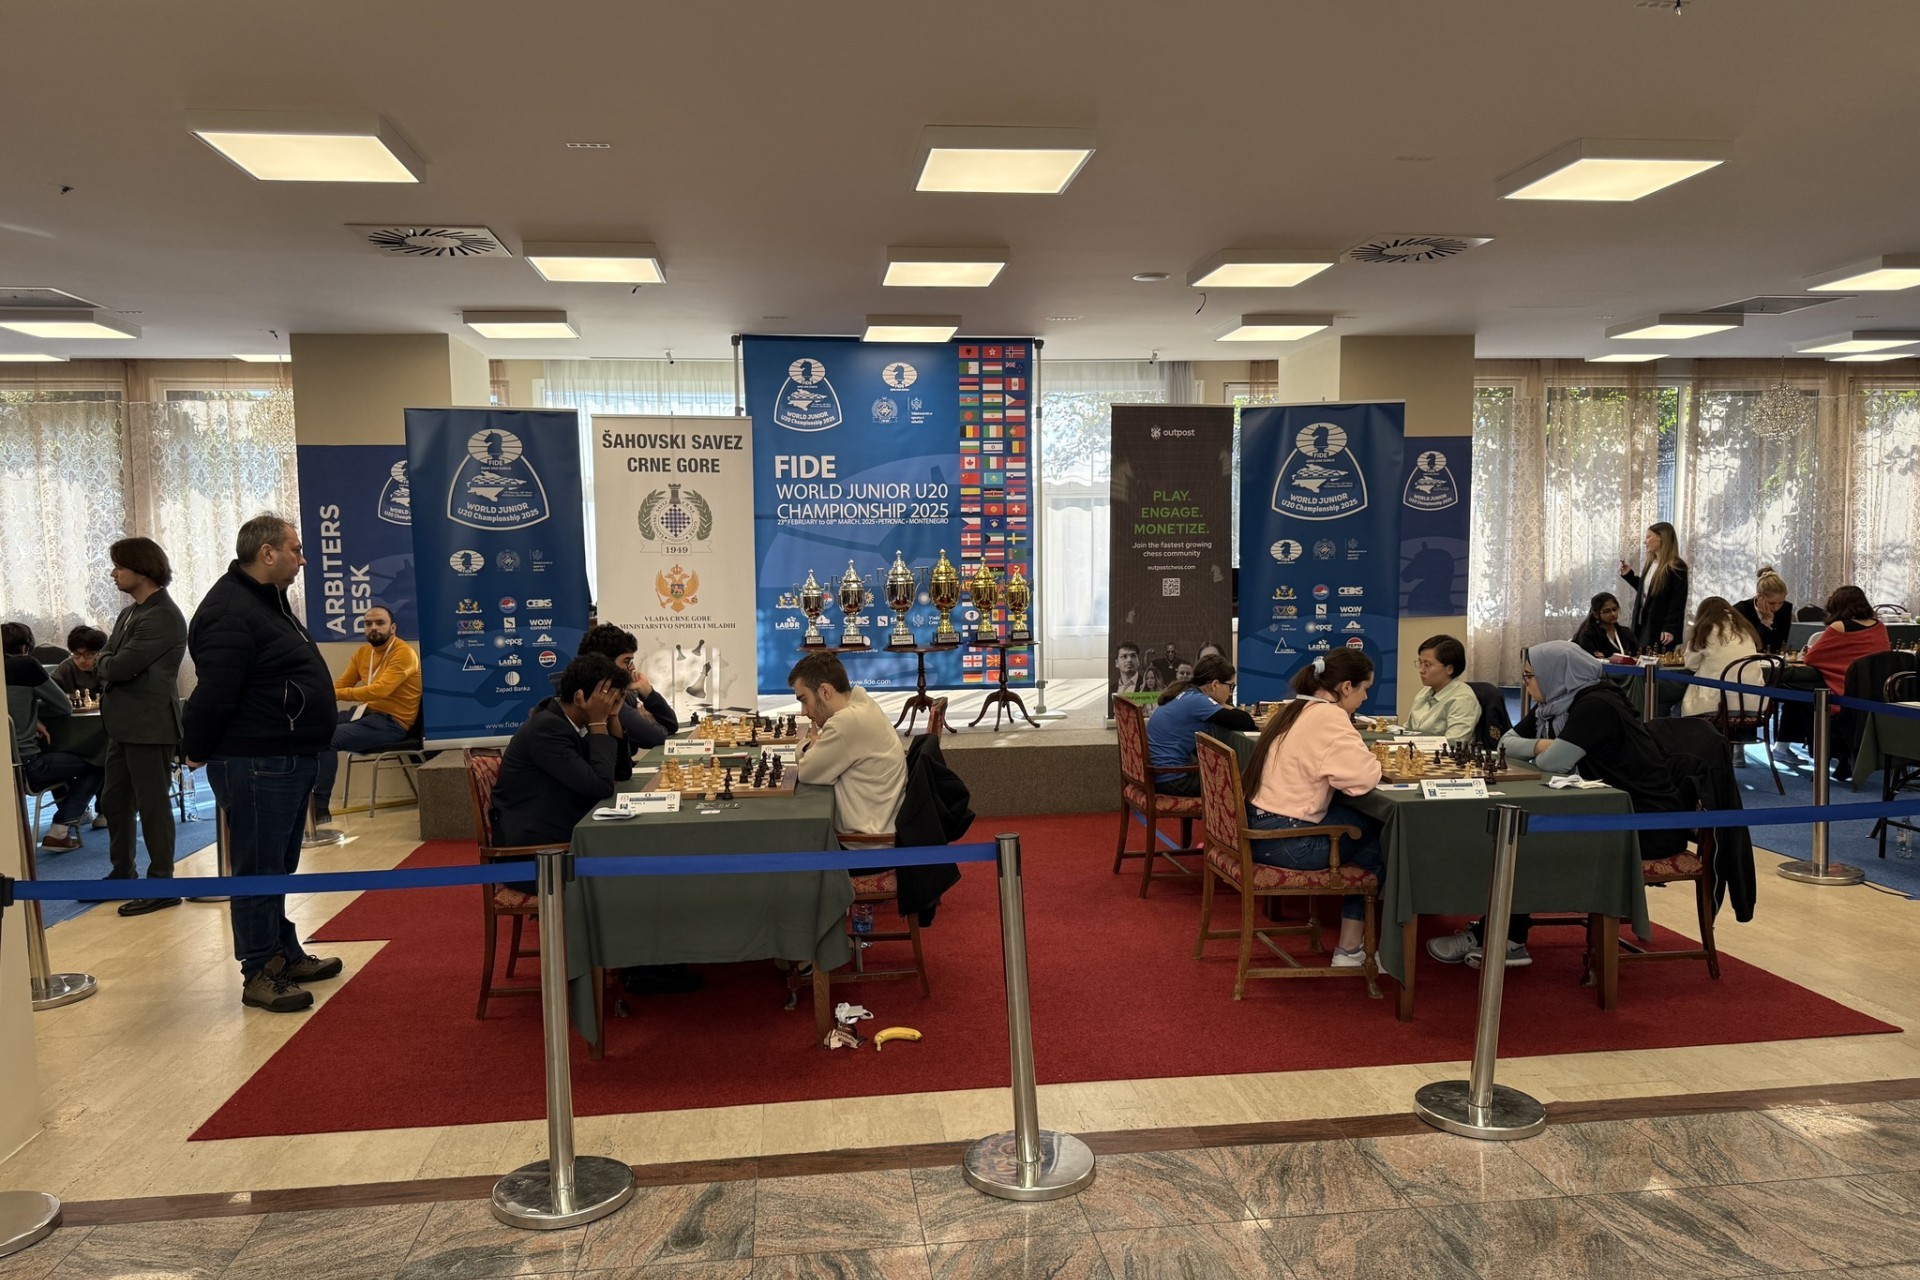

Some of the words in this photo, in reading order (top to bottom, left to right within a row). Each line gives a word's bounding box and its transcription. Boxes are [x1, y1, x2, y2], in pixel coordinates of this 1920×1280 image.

[787, 411, 806, 420] WORLD
[808, 411, 828, 420] JUNIOR
[791, 418, 822, 426] Championship
[1163, 429, 1195, 438] outpost
[602, 430, 686, 449] ŠAHOVSKI
[692, 434, 743, 450] SAVEZ
[627, 457, 671, 472] CRNE
[676, 458, 720, 473] GORE
[774, 455, 837, 479] FIDE
[776, 484, 842, 500] WORLD
[846, 483, 910, 500] JUNIOR
[915, 483, 948, 499] U20
[1153, 490, 1191, 502] PLAY.
[1290, 494, 1317, 504] WORLD
[1318, 493, 1348, 504] JUNIOR
[466, 502, 496, 514] WORLD
[498, 502, 529, 514] JUNIOR
[776, 503, 906, 519] CHAMPIONSHIP
[910, 503, 949, 518] 2025
[1141, 507, 1203, 518] ENGAGE.
[1281, 500, 1294, 508] U20
[1295, 503, 1340, 514] Championship
[1340, 499, 1358, 509] 2025
[458, 508, 472, 517] U20
[473, 511, 520, 523] Championship
[522, 509, 539, 519] 2025
[1134, 523, 1210, 535] MONETIZE.
[665, 546, 688, 554] 1949
[1185, 542, 1212, 550] growing
[1163, 550, 1201, 558] community
[319, 504, 347, 635] ARBITERS
[350, 564, 372, 634] DESK
[505, 638, 523, 646] epcg
